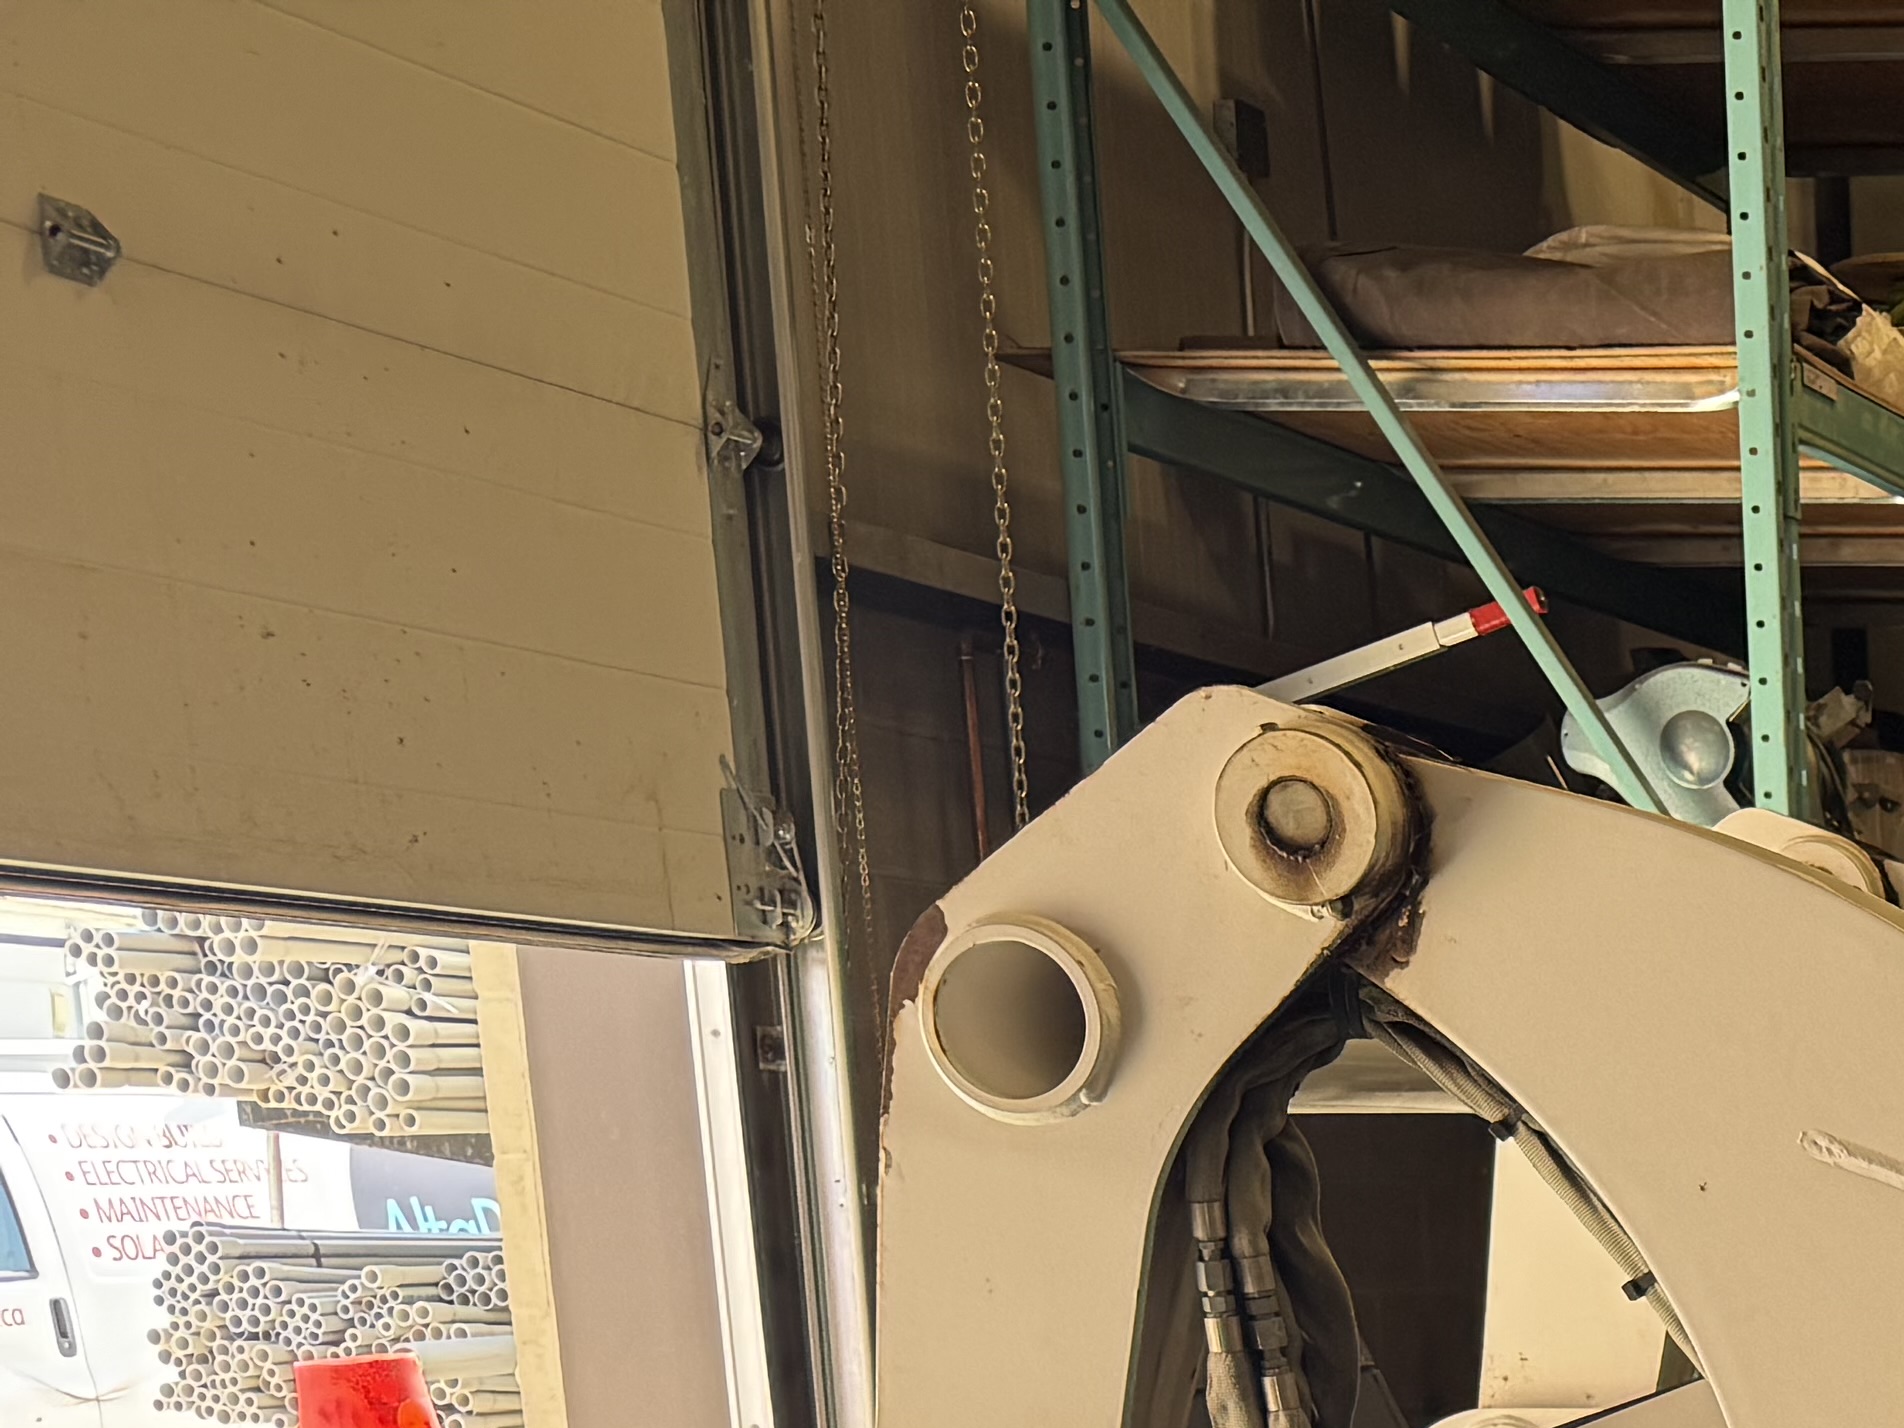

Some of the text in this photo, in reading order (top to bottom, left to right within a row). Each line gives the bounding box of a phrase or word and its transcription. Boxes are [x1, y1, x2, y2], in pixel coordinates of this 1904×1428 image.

[78, 1159, 308, 1186] ELECTRICAL SERVES
[93, 1195, 260, 1223] MAINTENANCE
[106, 1233, 167, 1261] SOLA
